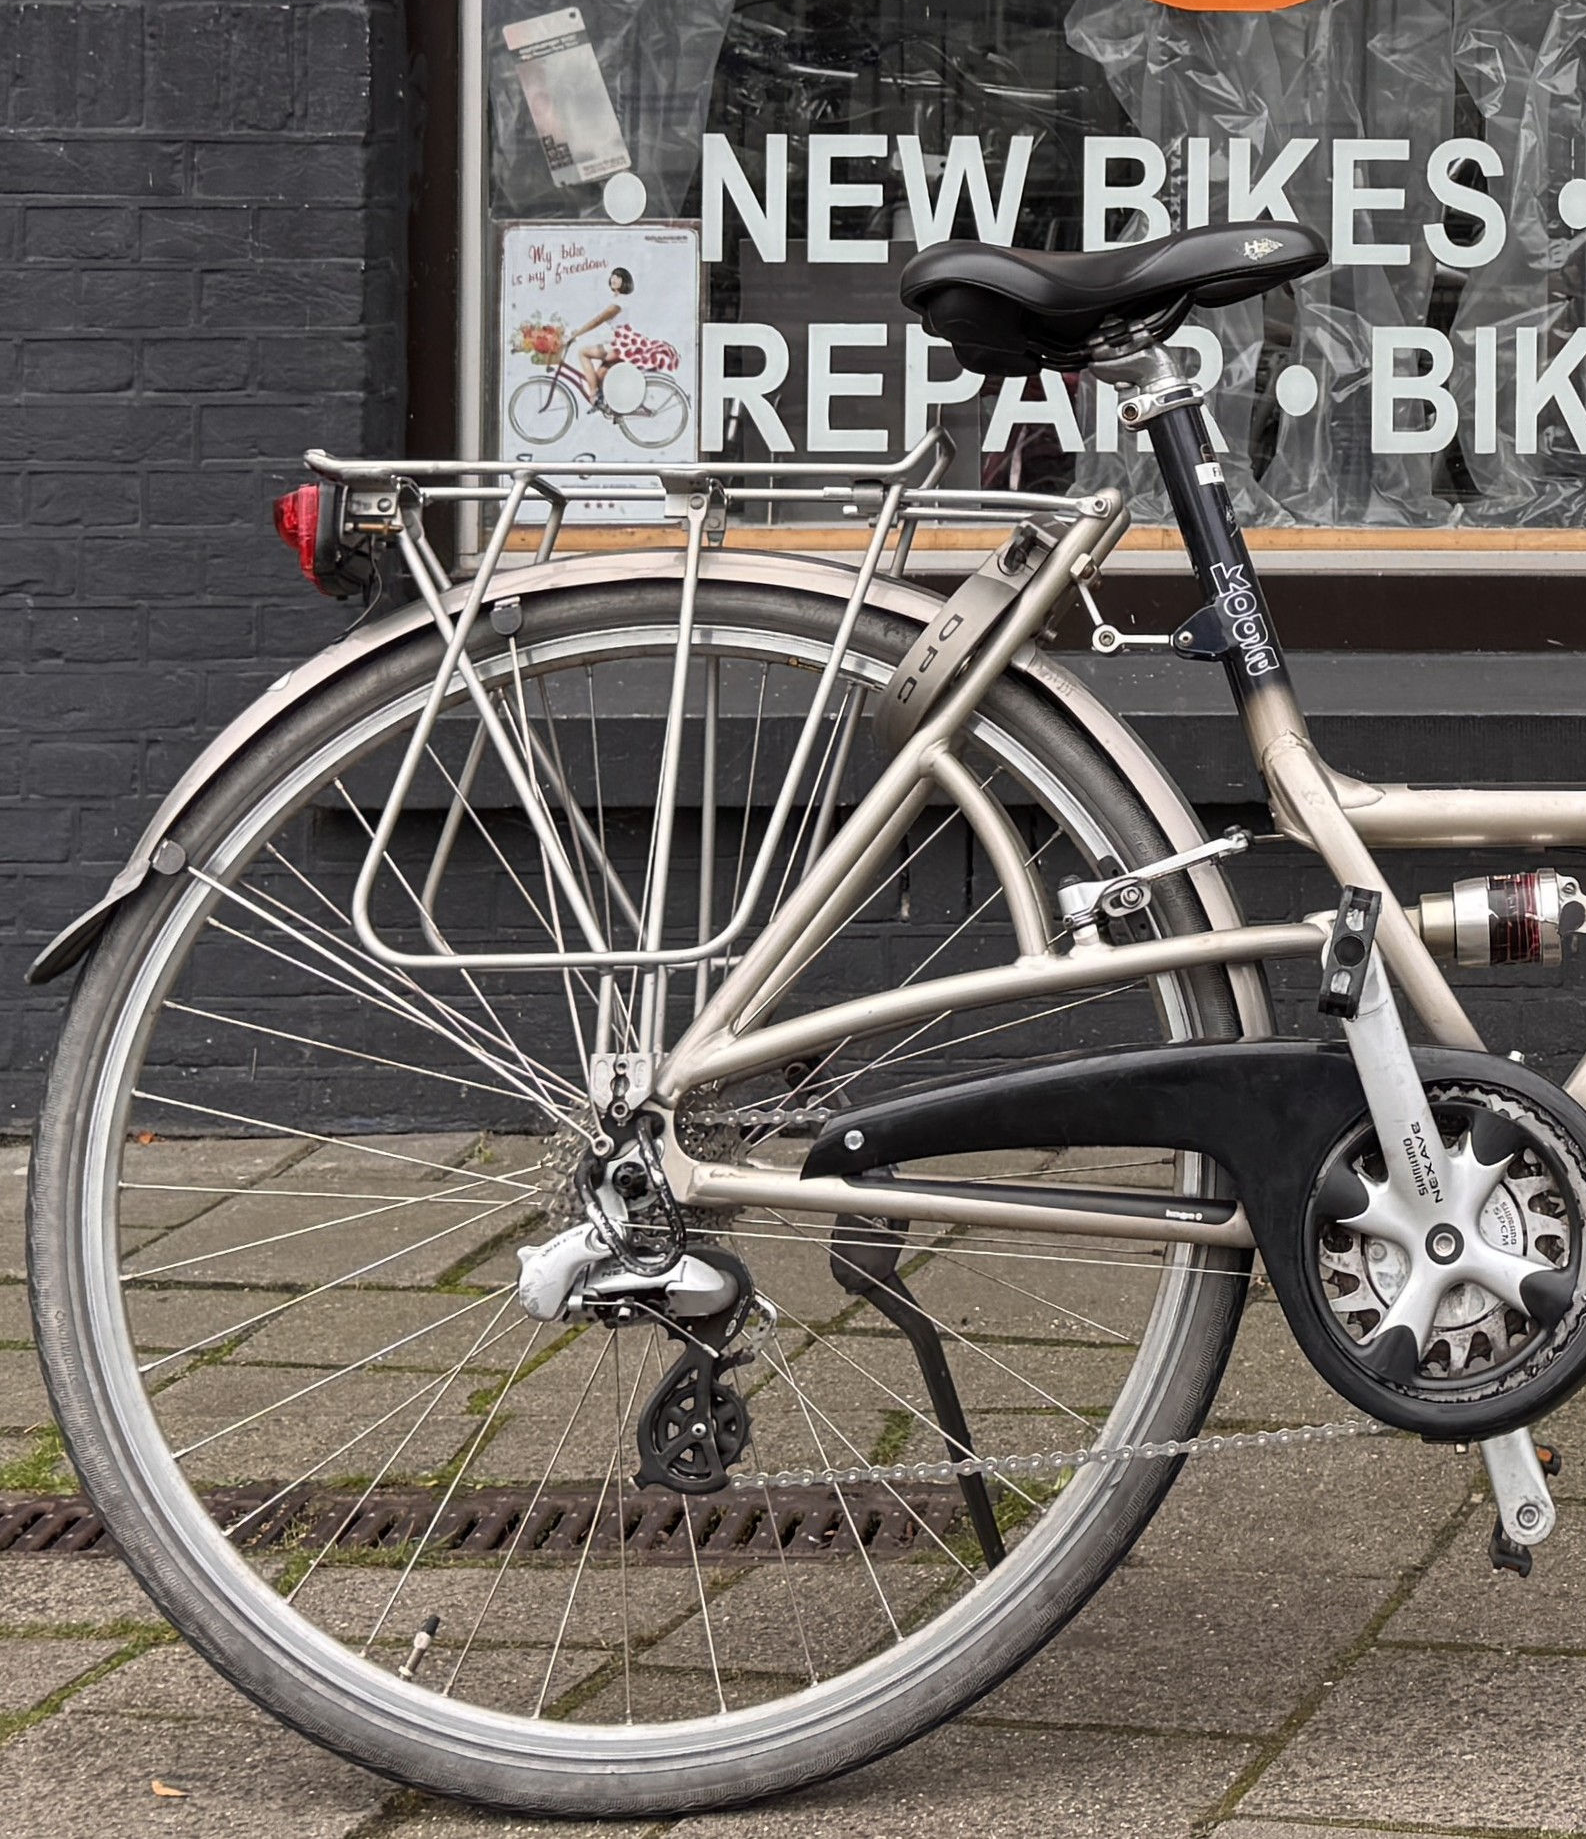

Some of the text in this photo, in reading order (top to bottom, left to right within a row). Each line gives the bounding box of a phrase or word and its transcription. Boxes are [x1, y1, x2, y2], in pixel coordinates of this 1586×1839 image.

[701, 133, 1034, 263] NEW
[1083, 135, 1507, 269] BIKES
[528, 242, 586, 271] My bike
[528, 270, 546, 290] my
[555, 257, 609, 285] freedom
[896, 613, 966, 707] DPC
[1403, 1137, 1429, 1196] SHIMANO
